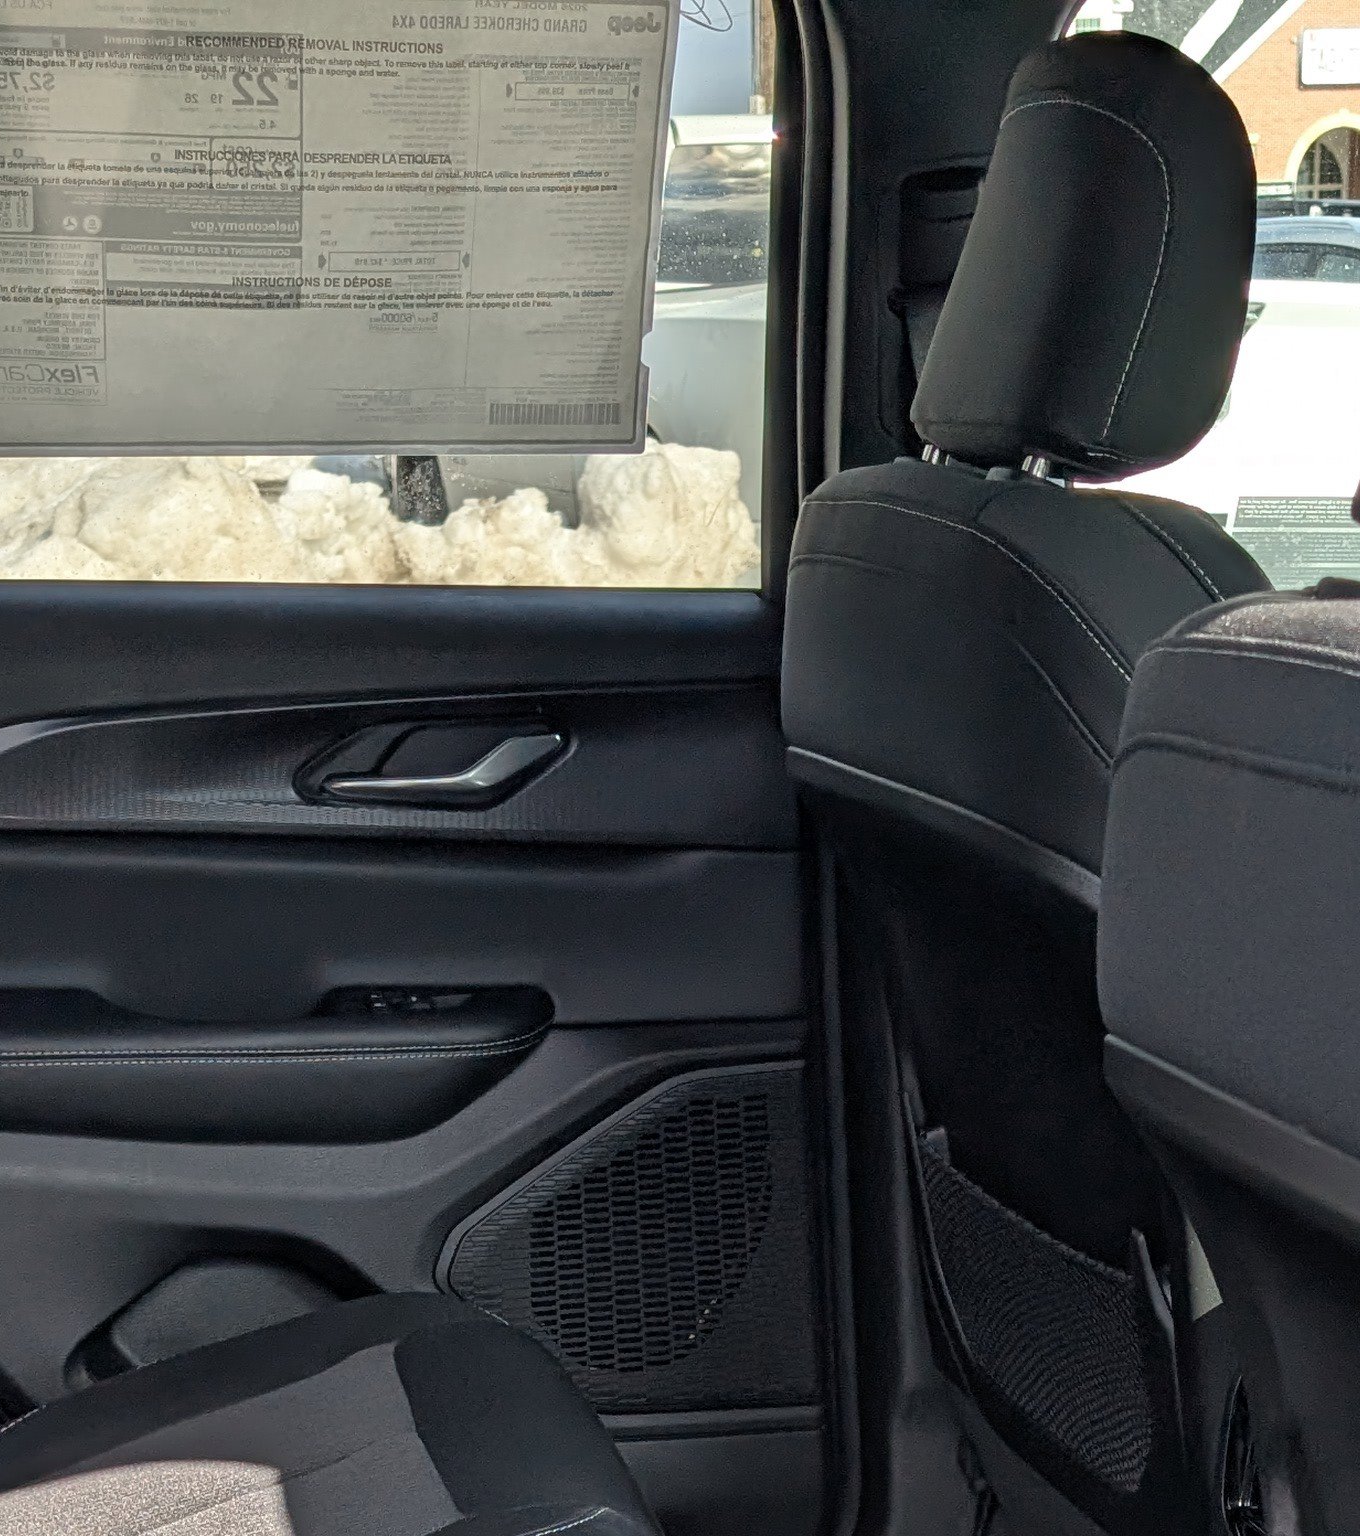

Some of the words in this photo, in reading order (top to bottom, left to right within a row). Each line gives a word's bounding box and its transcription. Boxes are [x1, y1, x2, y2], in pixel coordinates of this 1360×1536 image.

[186, 36, 285, 48] RECOMMENDED
[288, 38, 348, 51] REMOVAL
[352, 40, 443, 53] INSTRUCTIONS
[174, 150, 266, 162] INSTRUCCIONES
[269, 151, 300, 162] PARA
[304, 153, 380, 164] DESPRENDER
[382, 154, 397, 164] LA
[399, 154, 452, 165] ETIQUETA
[232, 276, 320, 287] INSTRUCTIONS
[324, 278, 340, 288] DE
[343, 276, 392, 288] DÉPOSE
